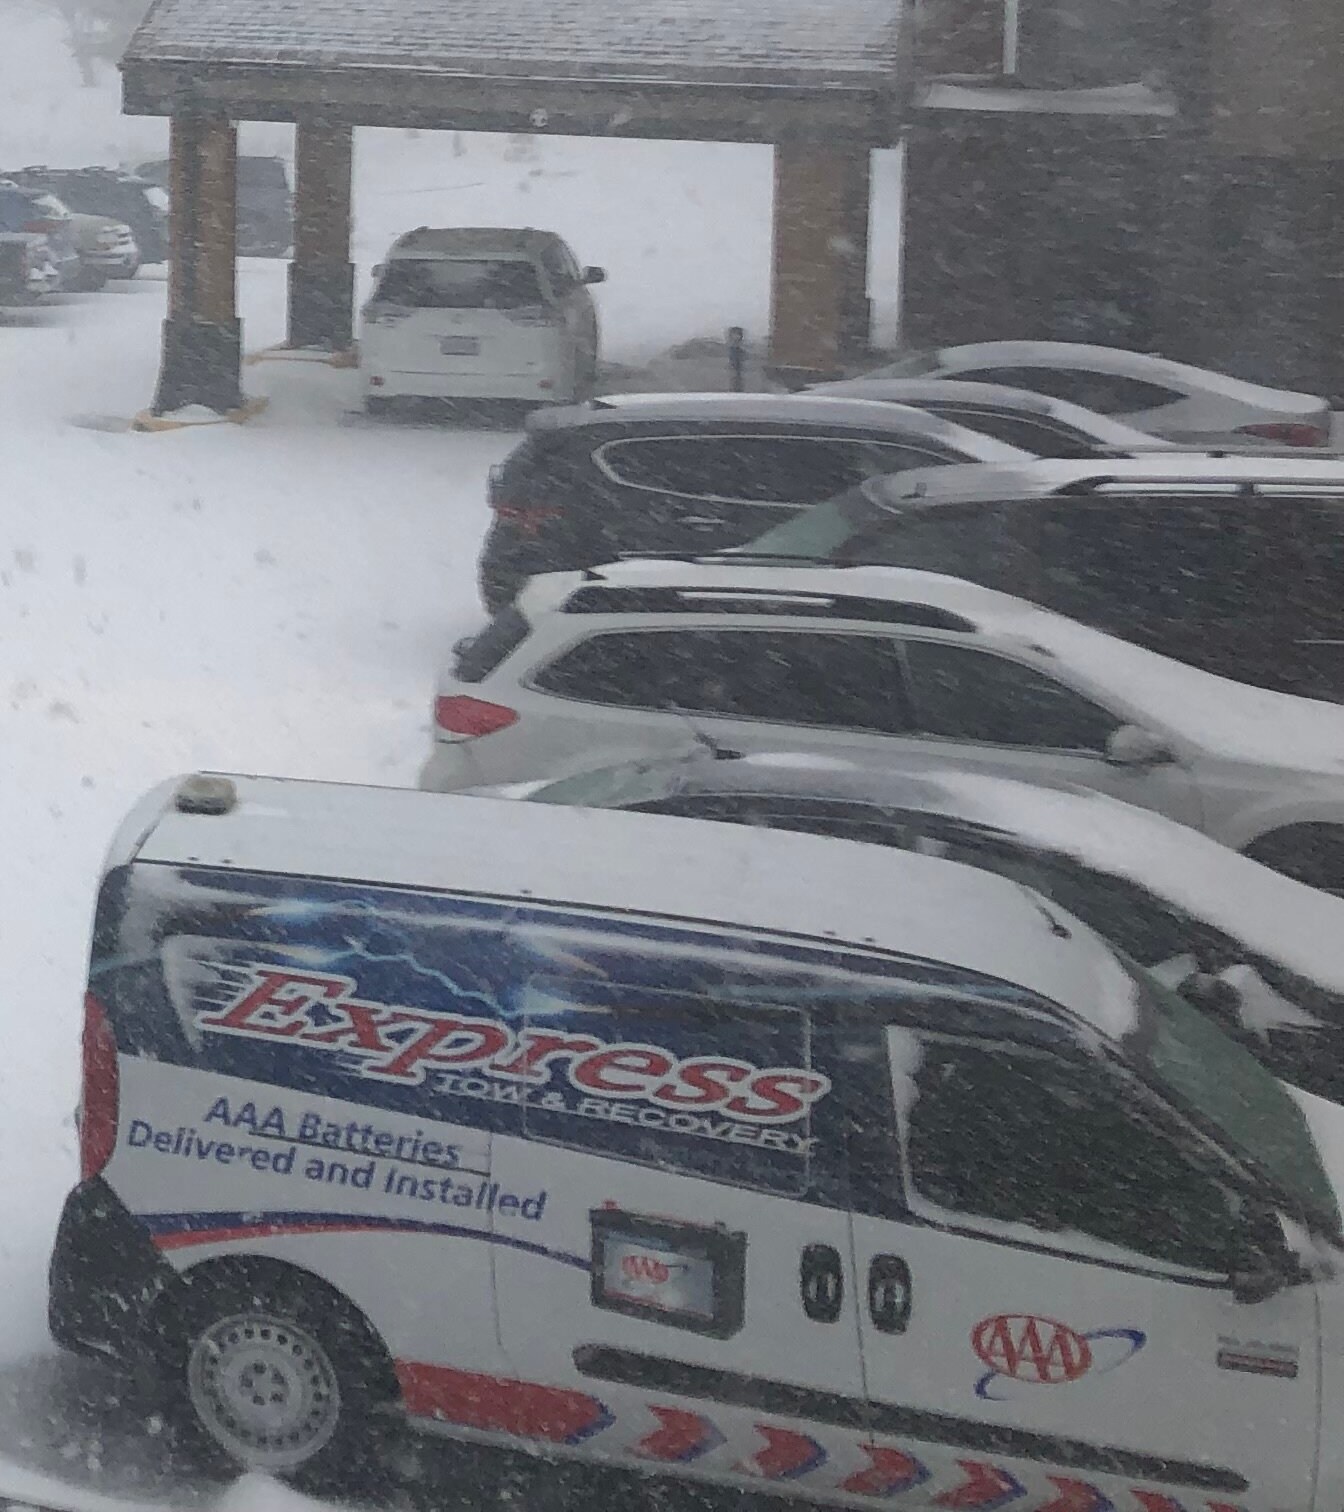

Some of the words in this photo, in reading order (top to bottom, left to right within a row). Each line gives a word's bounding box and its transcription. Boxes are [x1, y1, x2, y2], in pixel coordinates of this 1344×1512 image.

[196, 962, 832, 1124] Express
[203, 1095, 286, 1137] AAA
[297, 1111, 461, 1168] Batteries
[429, 1073, 529, 1104] TOW
[541, 1091, 565, 1112] &
[577, 1097, 820, 1154] RECOVERY
[127, 1119, 297, 1177] Delivered
[304, 1160, 375, 1190] and
[384, 1166, 548, 1222] Installed
[970, 1312, 1092, 1384] AAA
